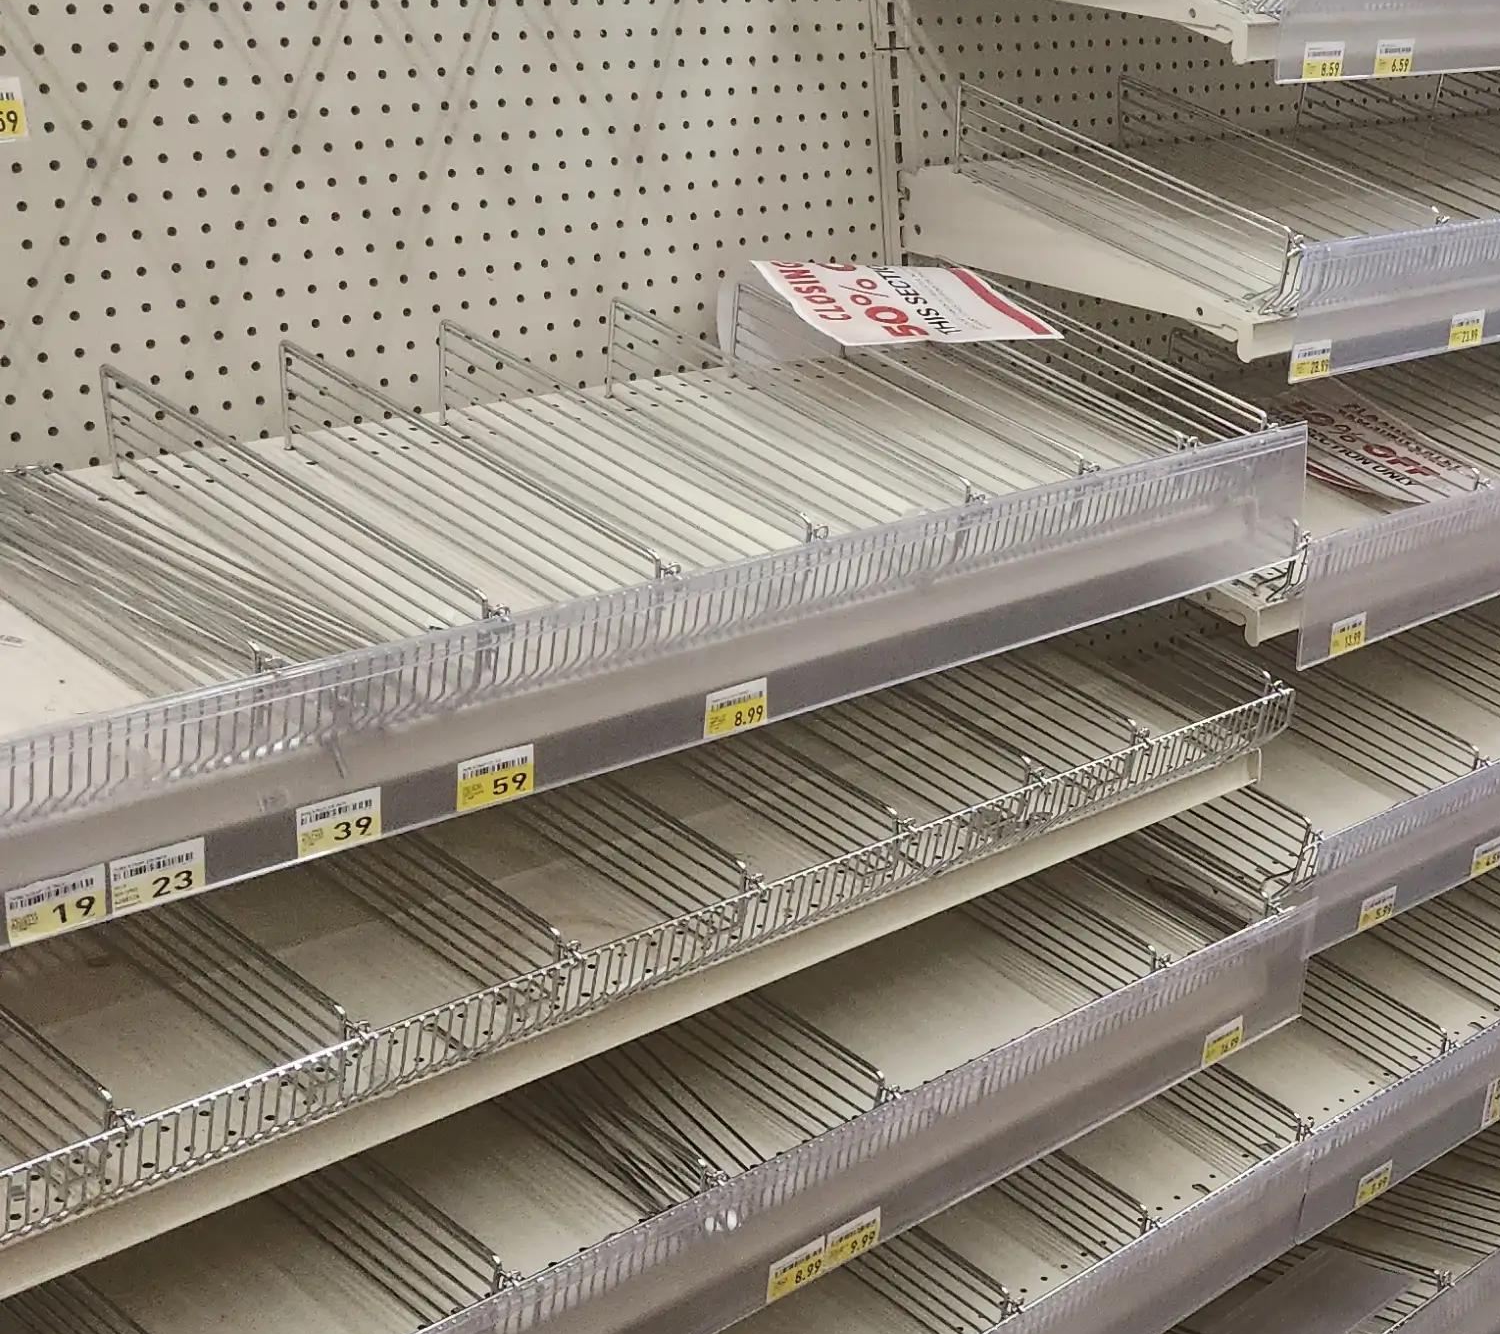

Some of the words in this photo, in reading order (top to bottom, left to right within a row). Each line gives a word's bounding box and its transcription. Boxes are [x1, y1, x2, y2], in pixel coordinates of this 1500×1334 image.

[1391, 58, 1409, 73] 6.59
[838, 278, 930, 337] 50%
[916, 307, 963, 336] THIS
[734, 705, 764, 727] 8.99
[493, 772, 527, 797] 59
[334, 816, 373, 840] 39
[152, 870, 193, 898] 23
[53, 896, 96, 924] 19
[850, 1230, 876, 1254] 9.99
